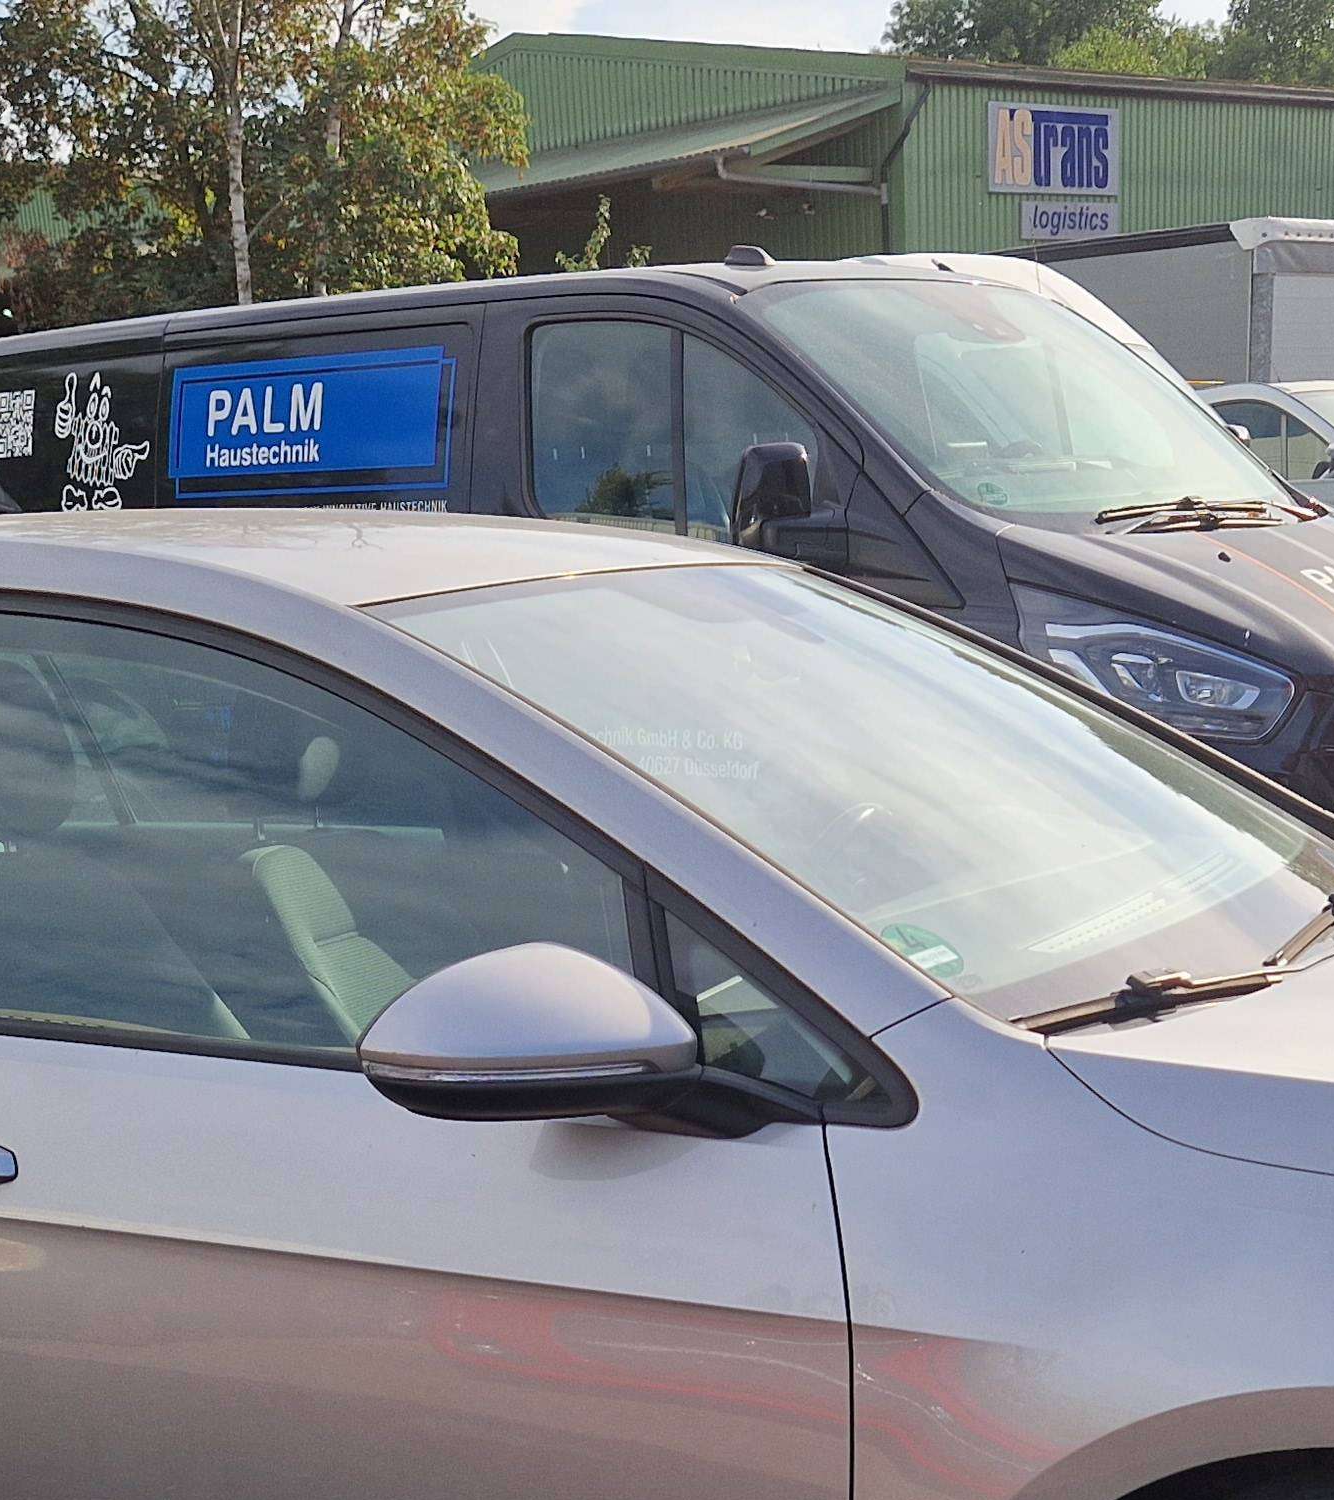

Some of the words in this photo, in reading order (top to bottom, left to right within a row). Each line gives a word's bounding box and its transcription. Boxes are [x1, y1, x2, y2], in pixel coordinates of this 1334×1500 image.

[1032, 204, 1109, 236] logistics
[207, 382, 324, 437] PALM
[206, 438, 320, 468] Haustechnik
[638, 727, 678, 748] GmbH
[681, 729, 691, 750] &
[697, 729, 720, 751] Co.
[723, 728, 744, 750] KG
[684, 757, 759, 779] Düsseldorf
